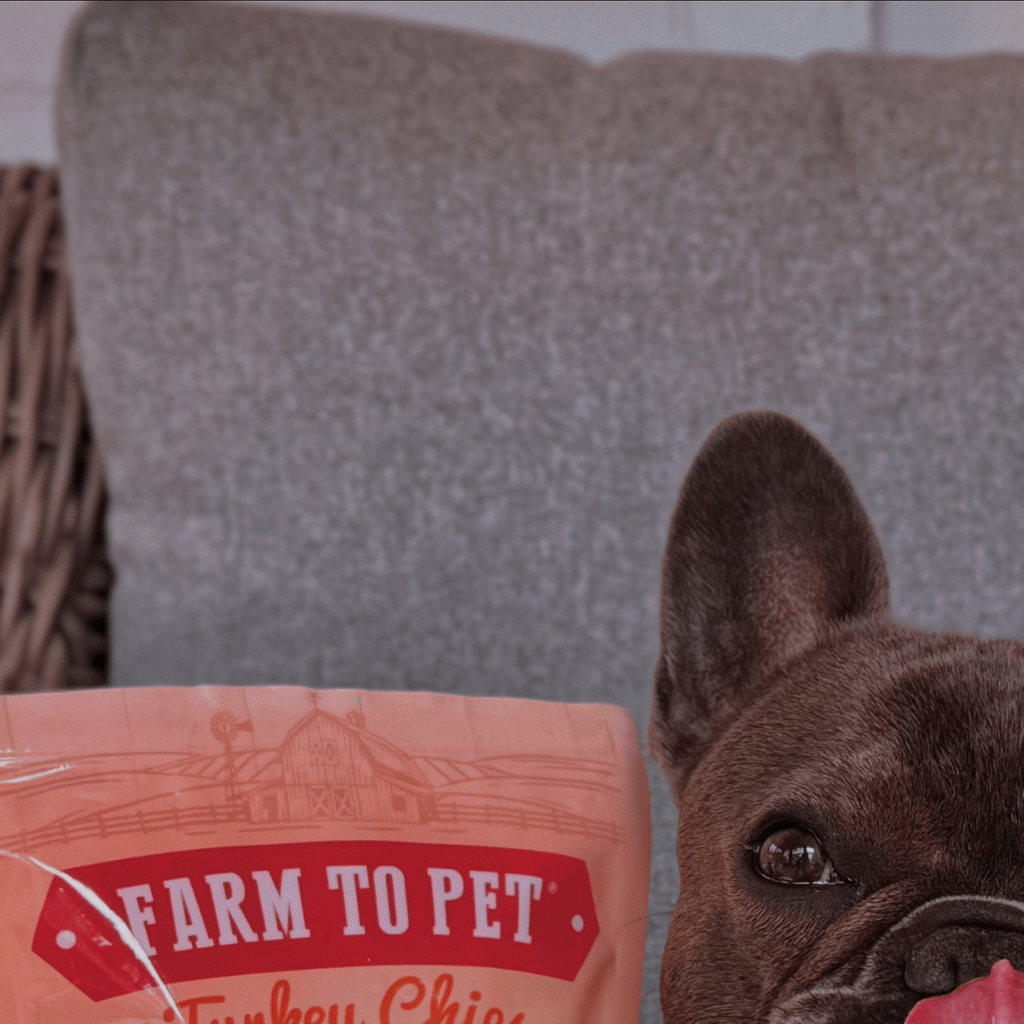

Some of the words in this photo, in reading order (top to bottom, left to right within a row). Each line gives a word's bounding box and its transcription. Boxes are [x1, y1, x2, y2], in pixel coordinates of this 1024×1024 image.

[115, 867, 312, 957] FARM
[325, 864, 407, 936] TO
[427, 866, 544, 945] PET
